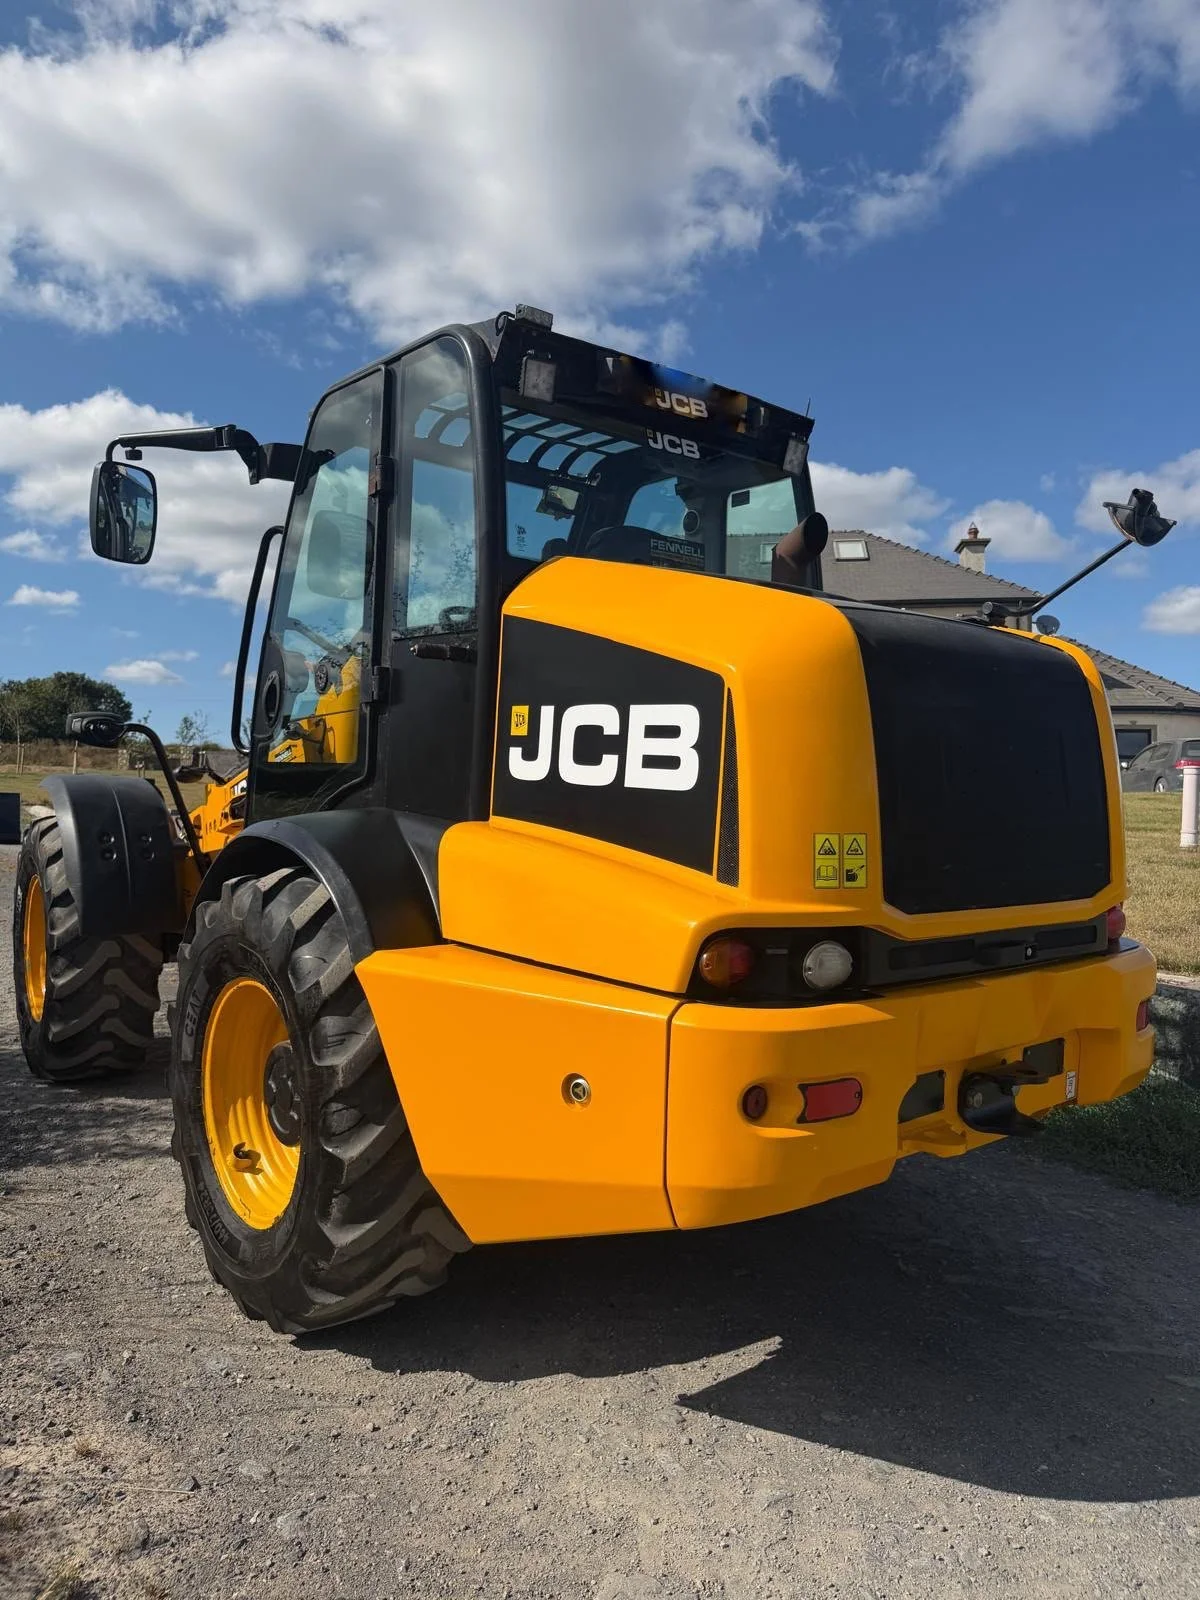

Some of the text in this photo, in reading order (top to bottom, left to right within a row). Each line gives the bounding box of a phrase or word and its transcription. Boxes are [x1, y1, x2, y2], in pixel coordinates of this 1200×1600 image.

[655, 388, 708, 418] JCB
[648, 429, 700, 459] JCB
[650, 538, 705, 558] FENNELL
[508, 704, 700, 792] JCB
